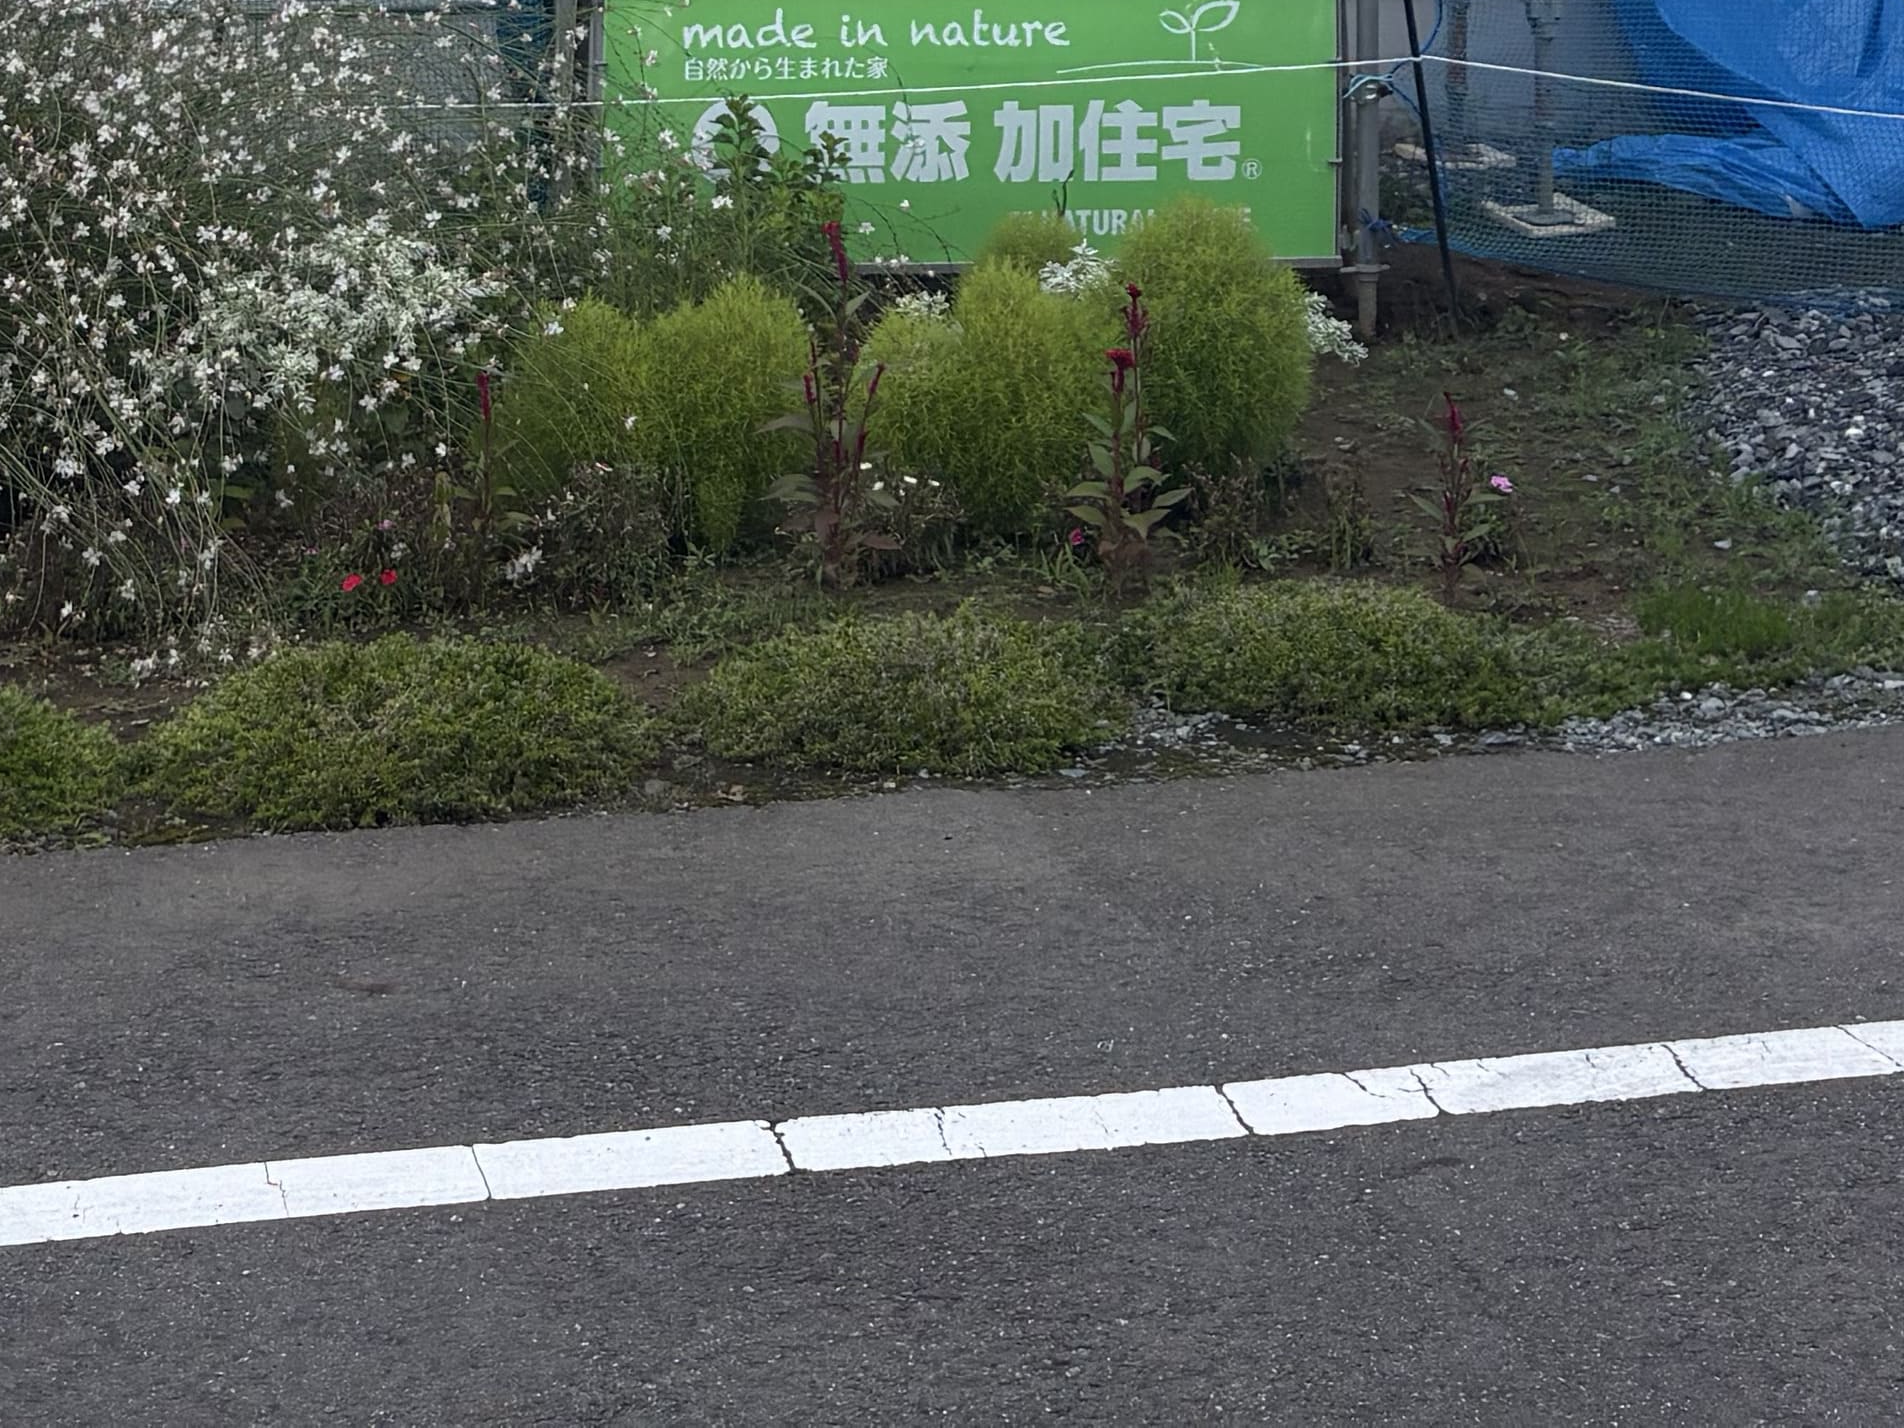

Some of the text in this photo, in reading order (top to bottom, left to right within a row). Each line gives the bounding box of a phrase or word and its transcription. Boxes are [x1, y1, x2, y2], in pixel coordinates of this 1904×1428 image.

[682, 8, 1071, 49] made in nature
[683, 56, 890, 82] 自然から生まれた家
